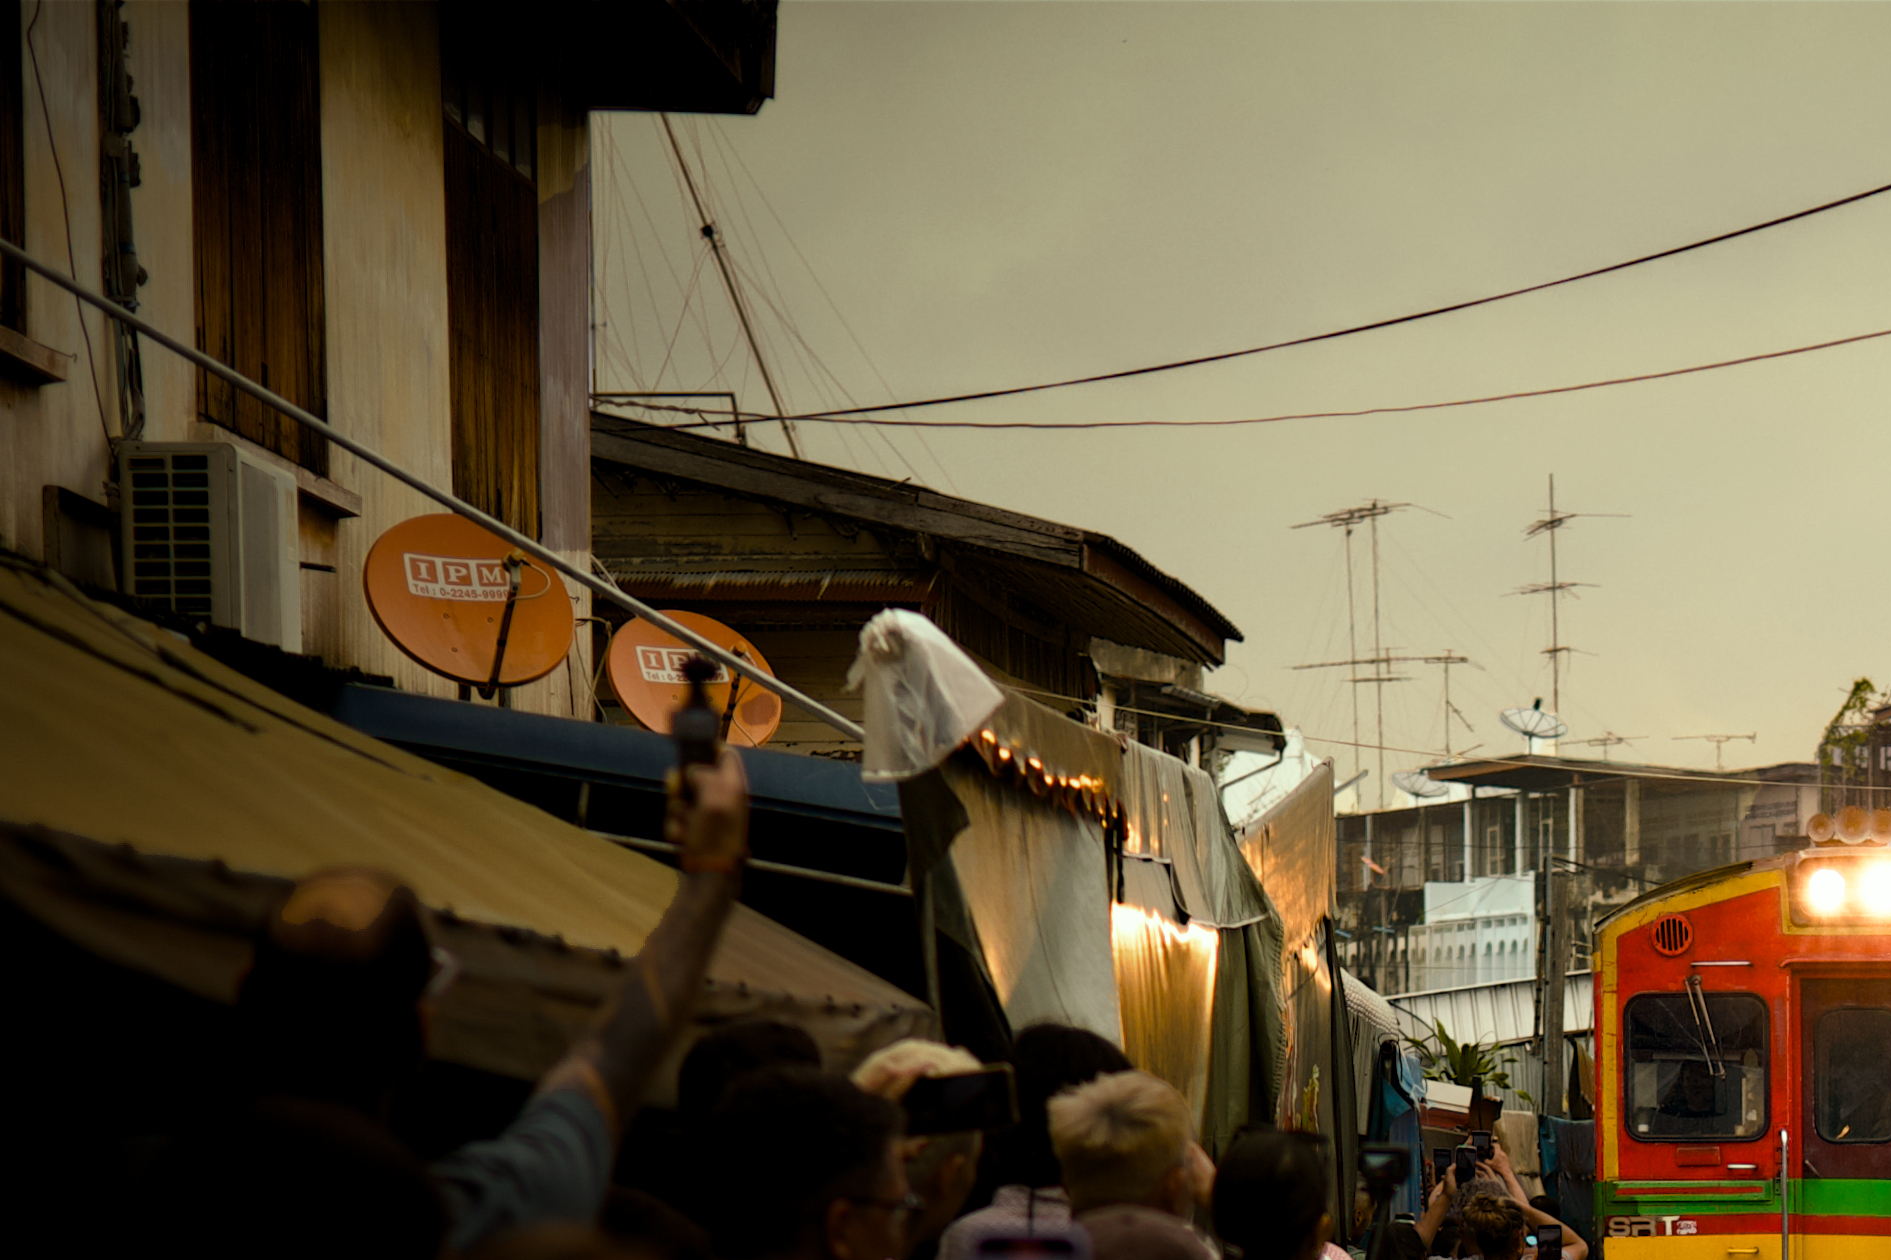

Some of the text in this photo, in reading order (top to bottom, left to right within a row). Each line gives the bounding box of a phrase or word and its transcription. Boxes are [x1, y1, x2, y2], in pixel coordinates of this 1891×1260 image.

[415, 561, 505, 584] IPM
[413, 584, 429, 594] Tel
[1608, 1215, 1680, 1237] SRT
